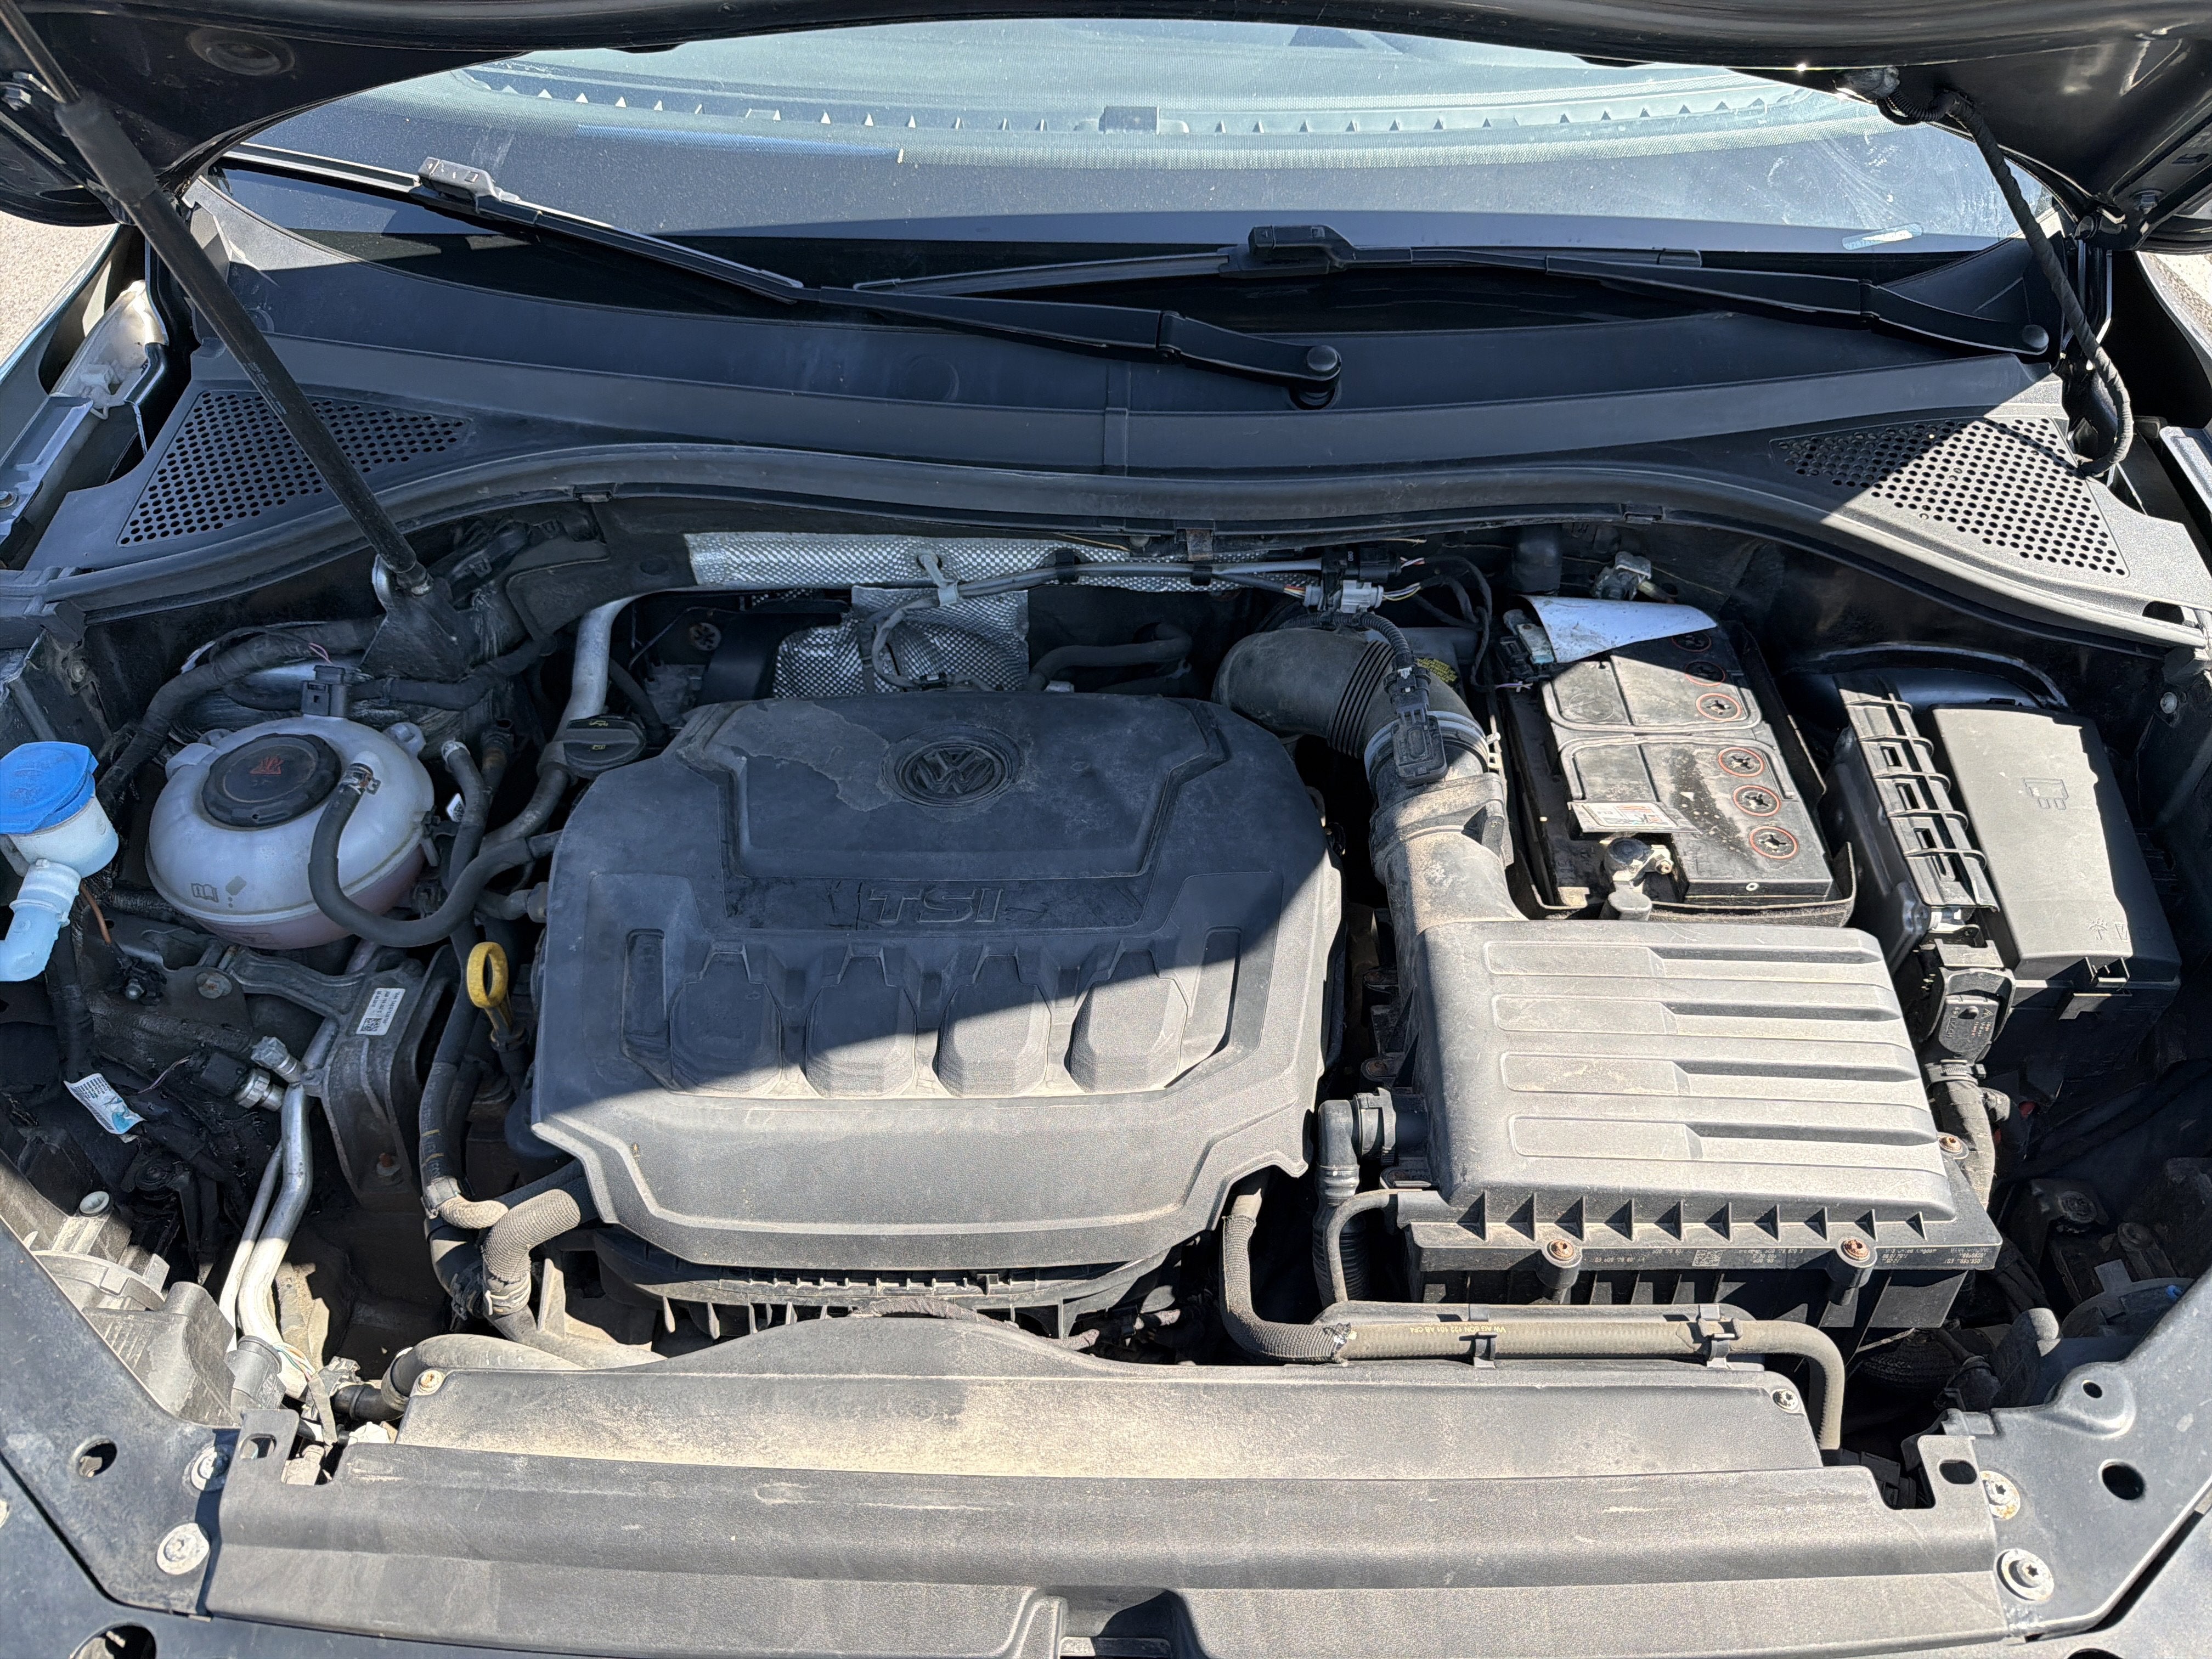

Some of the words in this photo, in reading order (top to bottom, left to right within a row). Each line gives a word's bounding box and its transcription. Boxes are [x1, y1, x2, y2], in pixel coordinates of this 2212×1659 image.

[908, 745, 1000, 797] VW
[869, 888, 1003, 923] TSI
[1494, 1326, 1506, 1334] VW
